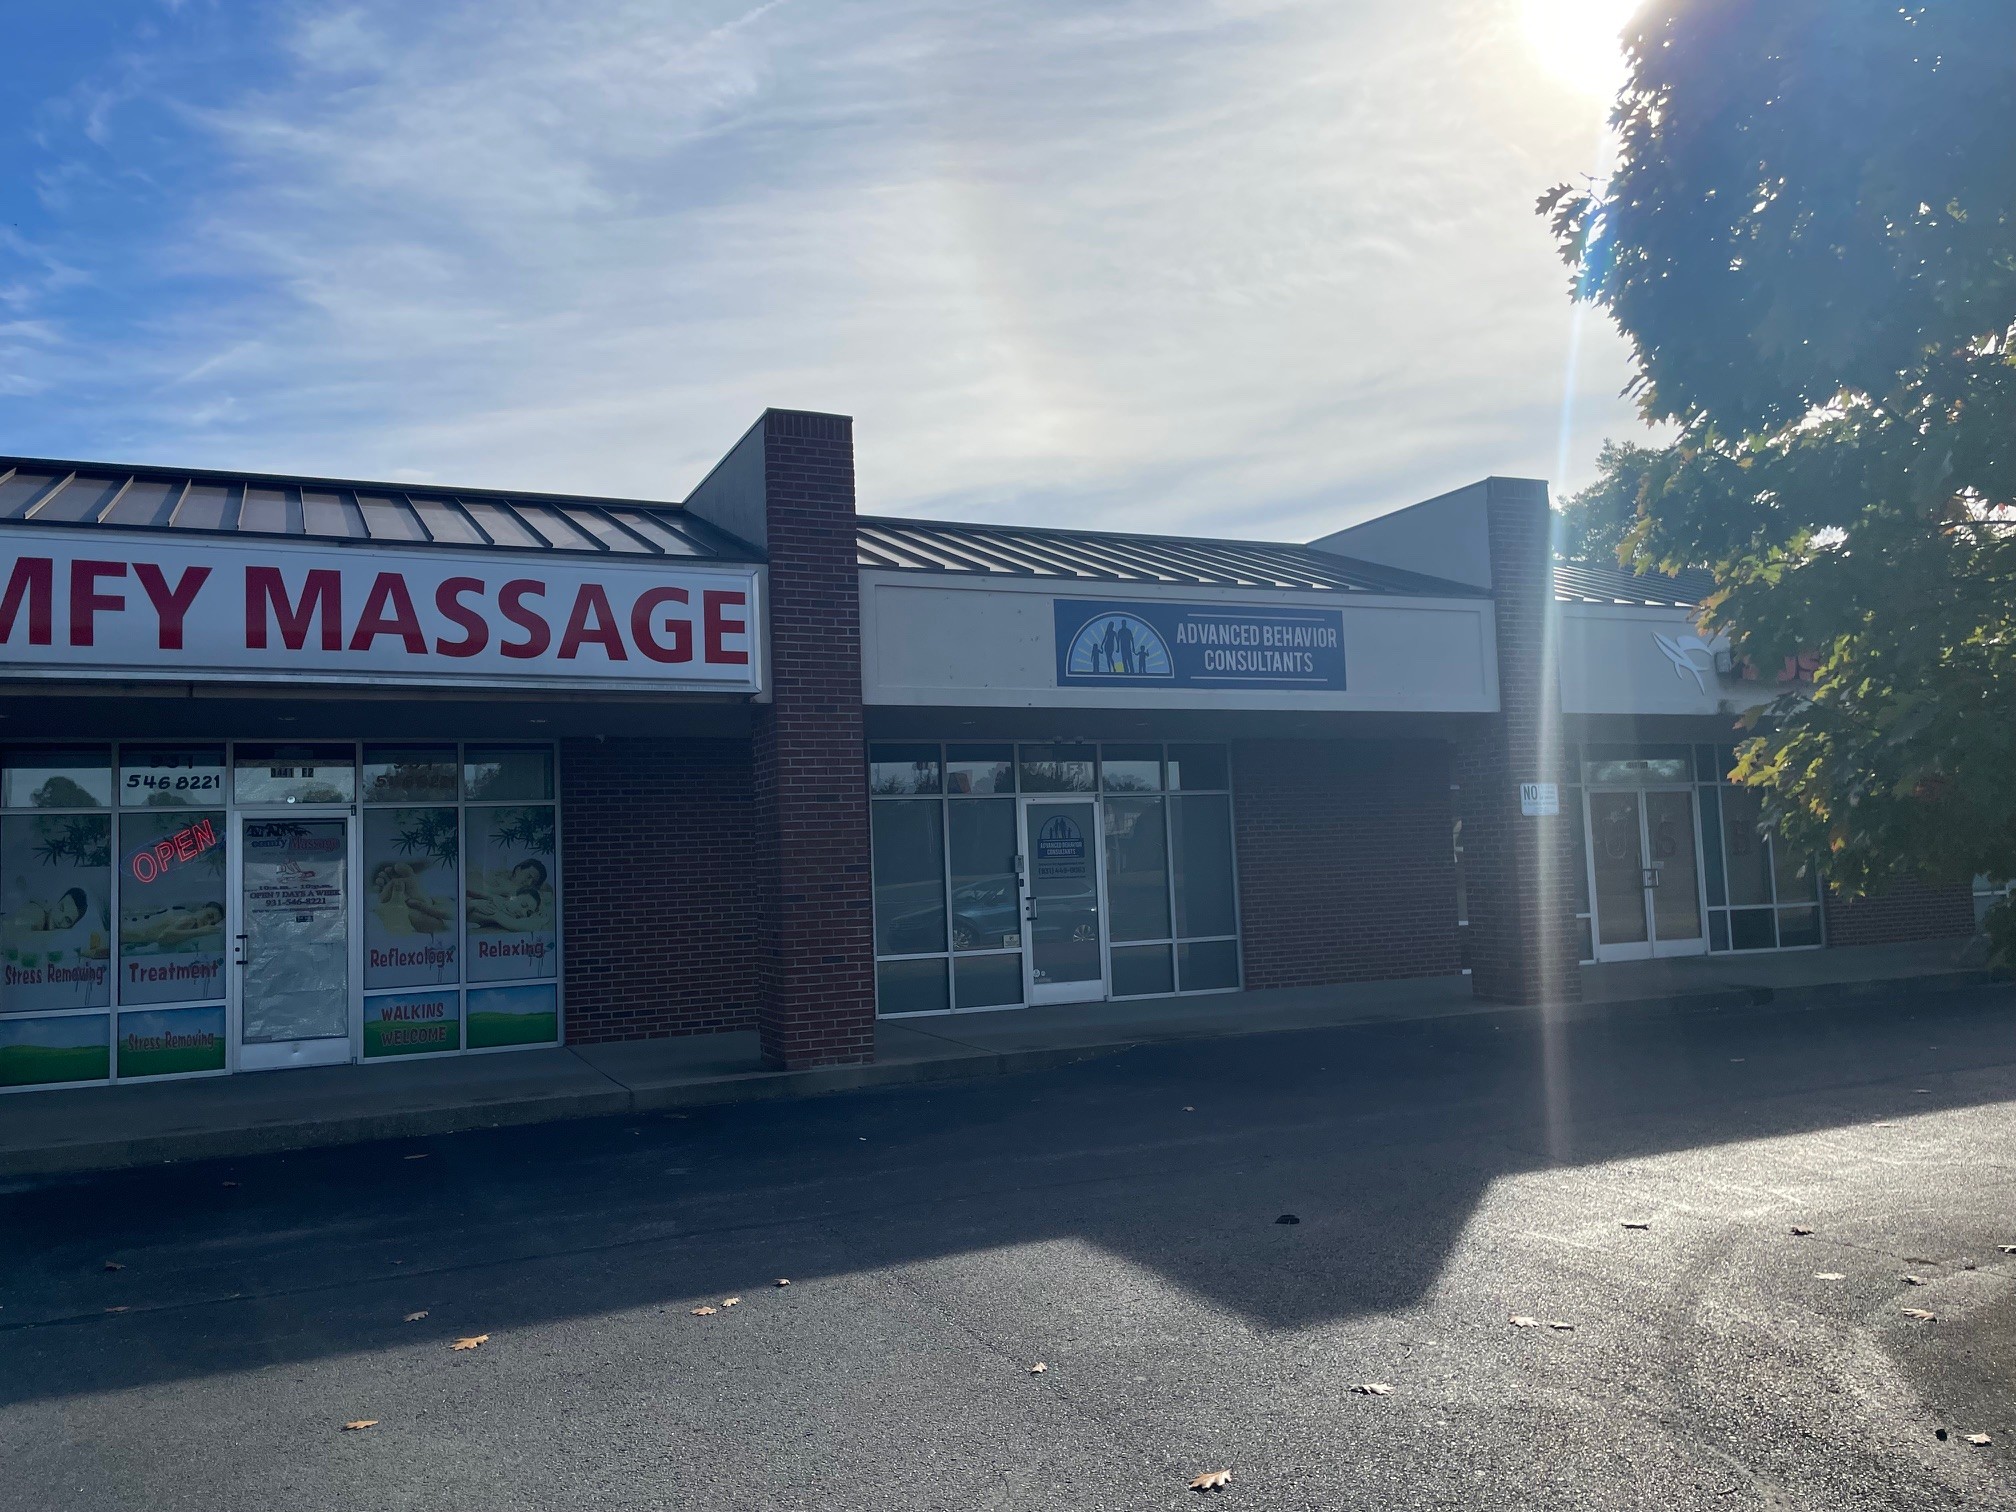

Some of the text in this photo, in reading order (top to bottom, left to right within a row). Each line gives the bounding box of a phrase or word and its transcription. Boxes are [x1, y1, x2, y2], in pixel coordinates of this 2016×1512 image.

[245, 565, 750, 665] MASSAGE
[1176, 622, 1338, 649] ADVANCED BEHAVIOR
[1204, 649, 1314, 673] CONSULTANTS
[1523, 785, 1538, 801] NO
[132, 818, 217, 884] OPEN
[249, 891, 274, 899] OPEN
[282, 890, 306, 898] DAYS
[316, 889, 341, 897] WEEK
[265, 897, 327, 907] 931-546-8221
[478, 939, 545, 959] Relaxing
[5, 964, 42, 986] Stress
[129, 960, 219, 983] Treatment
[381, 1002, 444, 1022] WALKINS
[128, 1029, 214, 1051] Stress Removing
[381, 1026, 446, 1047] WELCOME
